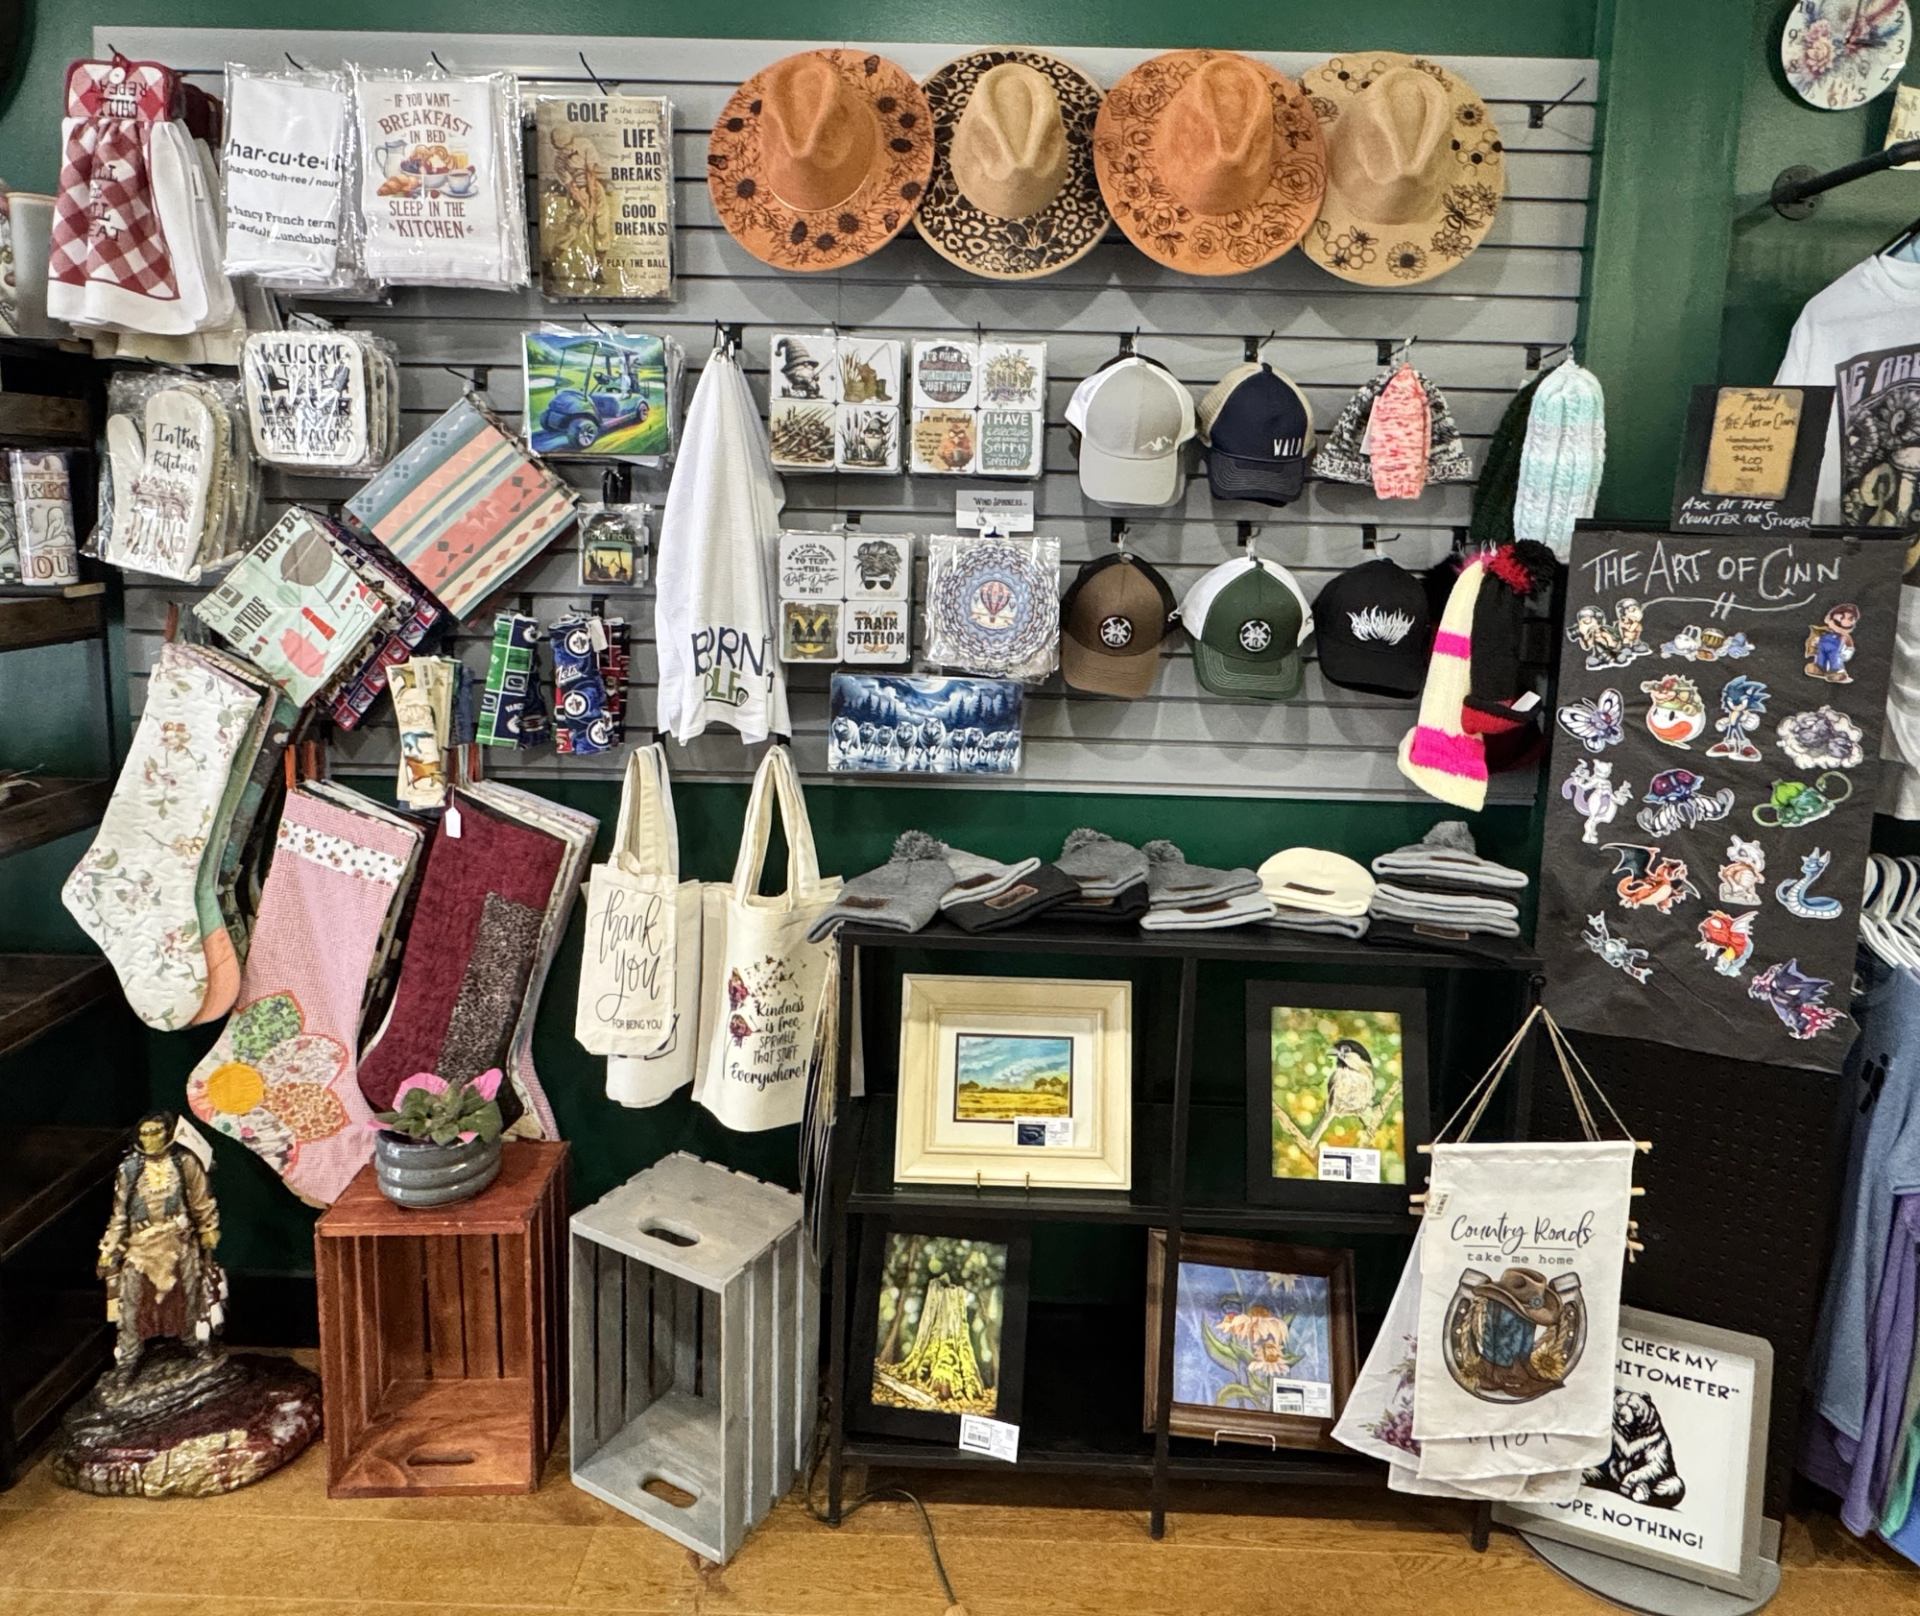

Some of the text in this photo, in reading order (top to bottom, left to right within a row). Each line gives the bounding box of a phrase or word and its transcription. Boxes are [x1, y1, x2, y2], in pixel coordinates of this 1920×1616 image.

[1896, 39, 1905, 54] 3
[1880, 68, 1890, 82] 4
[394, 92, 450, 107] IF YOU WANT
[1854, 87, 1867, 102] 5
[567, 102, 608, 122] GOLF
[377, 109, 472, 137] BREAKFAST
[410, 129, 446, 144] IN BED
[623, 128, 656, 148] LIFE
[635, 151, 661, 166] BAD
[611, 167, 662, 182] BREAKS
[389, 200, 466, 217] SLEEP IN THE
[622, 204, 657, 218] GOOD
[239, 221, 271, 238] adult
[307, 217, 336, 230] term
[396, 219, 464, 239] KITCHEN
[606, 259, 668, 268] PLAY THE BALL
[986, 413, 1029, 426] I HAVE
[152, 422, 200, 451] In this
[984, 438, 1027, 459] Sorry
[1681, 496, 1775, 511] ASK AT THE
[1678, 511, 1741, 526] COUNTER
[252, 528, 285, 563] HOT
[809, 557, 830, 565] TEST
[803, 565, 820, 573] THE
[1578, 540, 1841, 600] THE ART OF CINN
[227, 596, 273, 644] AND TURF
[854, 617, 898, 630] TRAIN
[847, 631, 905, 645] STATION
[754, 996, 805, 1017] Kindness
[612, 1018, 662, 1030] FOR BEING YOU
[765, 1019, 774, 1034] is
[730, 1058, 806, 1092] Everywhere!
[1450, 1210, 1596, 1255] Country Roads
[1467, 1252, 1574, 1265] take me home
[1621, 1337, 1718, 1372] CHECK MY
[1602, 1507, 1704, 1550] NOTHING!
